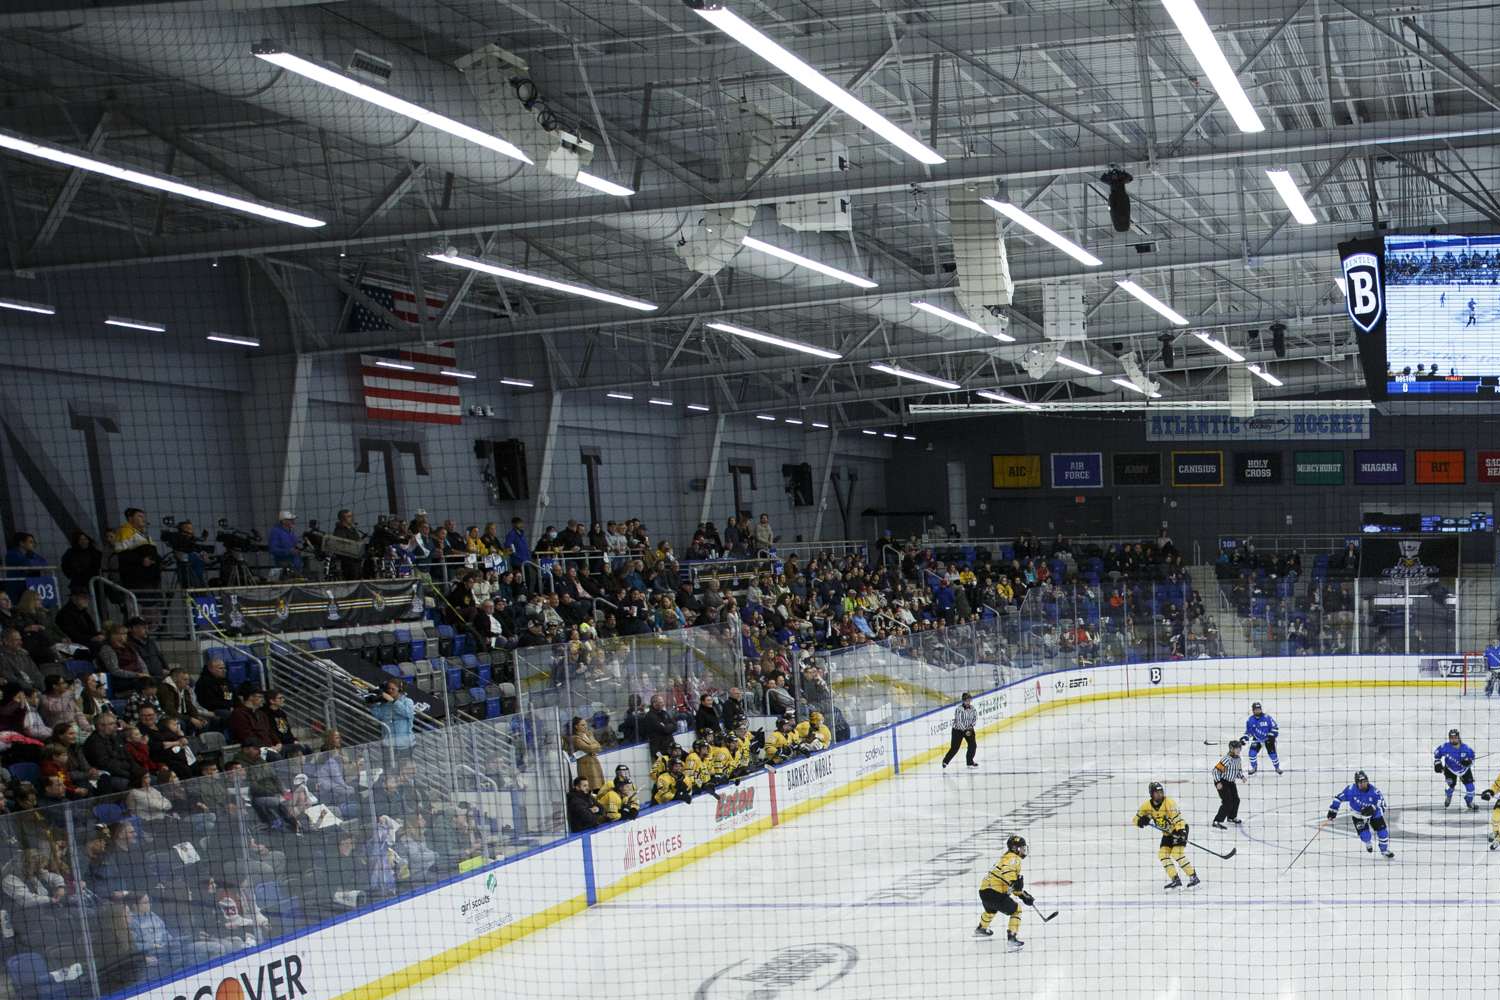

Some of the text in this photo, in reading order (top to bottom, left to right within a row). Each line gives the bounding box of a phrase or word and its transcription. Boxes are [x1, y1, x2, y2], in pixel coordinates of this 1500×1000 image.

[1349, 271, 1377, 314] B
[1151, 413, 1365, 434] ATLANTIC HOCKEY
[1070, 462, 1084, 470] AIR
[1125, 465, 1149, 474] ARMY
[1178, 464, 1216, 473] CANISIUS
[1247, 460, 1269, 469] HOLY
[1296, 464, 1341, 472] MERCYHURST
[1361, 463, 1398, 472] NIAGARA
[1431, 461, 1449, 473] RIT
[1008, 466, 1026, 477] AIC
[1064, 471, 1090, 480] FORCE
[1245, 469, 1271, 477] CROSS
[1222, 540, 1236, 548] 108
[715, 786, 754, 823] Eaton
[637, 825, 657, 846] C&W
[639, 834, 682, 864] SERVICES
[461, 895, 490, 916] girl scouts
[475, 908, 495, 922] eastern
[474, 913, 514, 936] massachusetts
